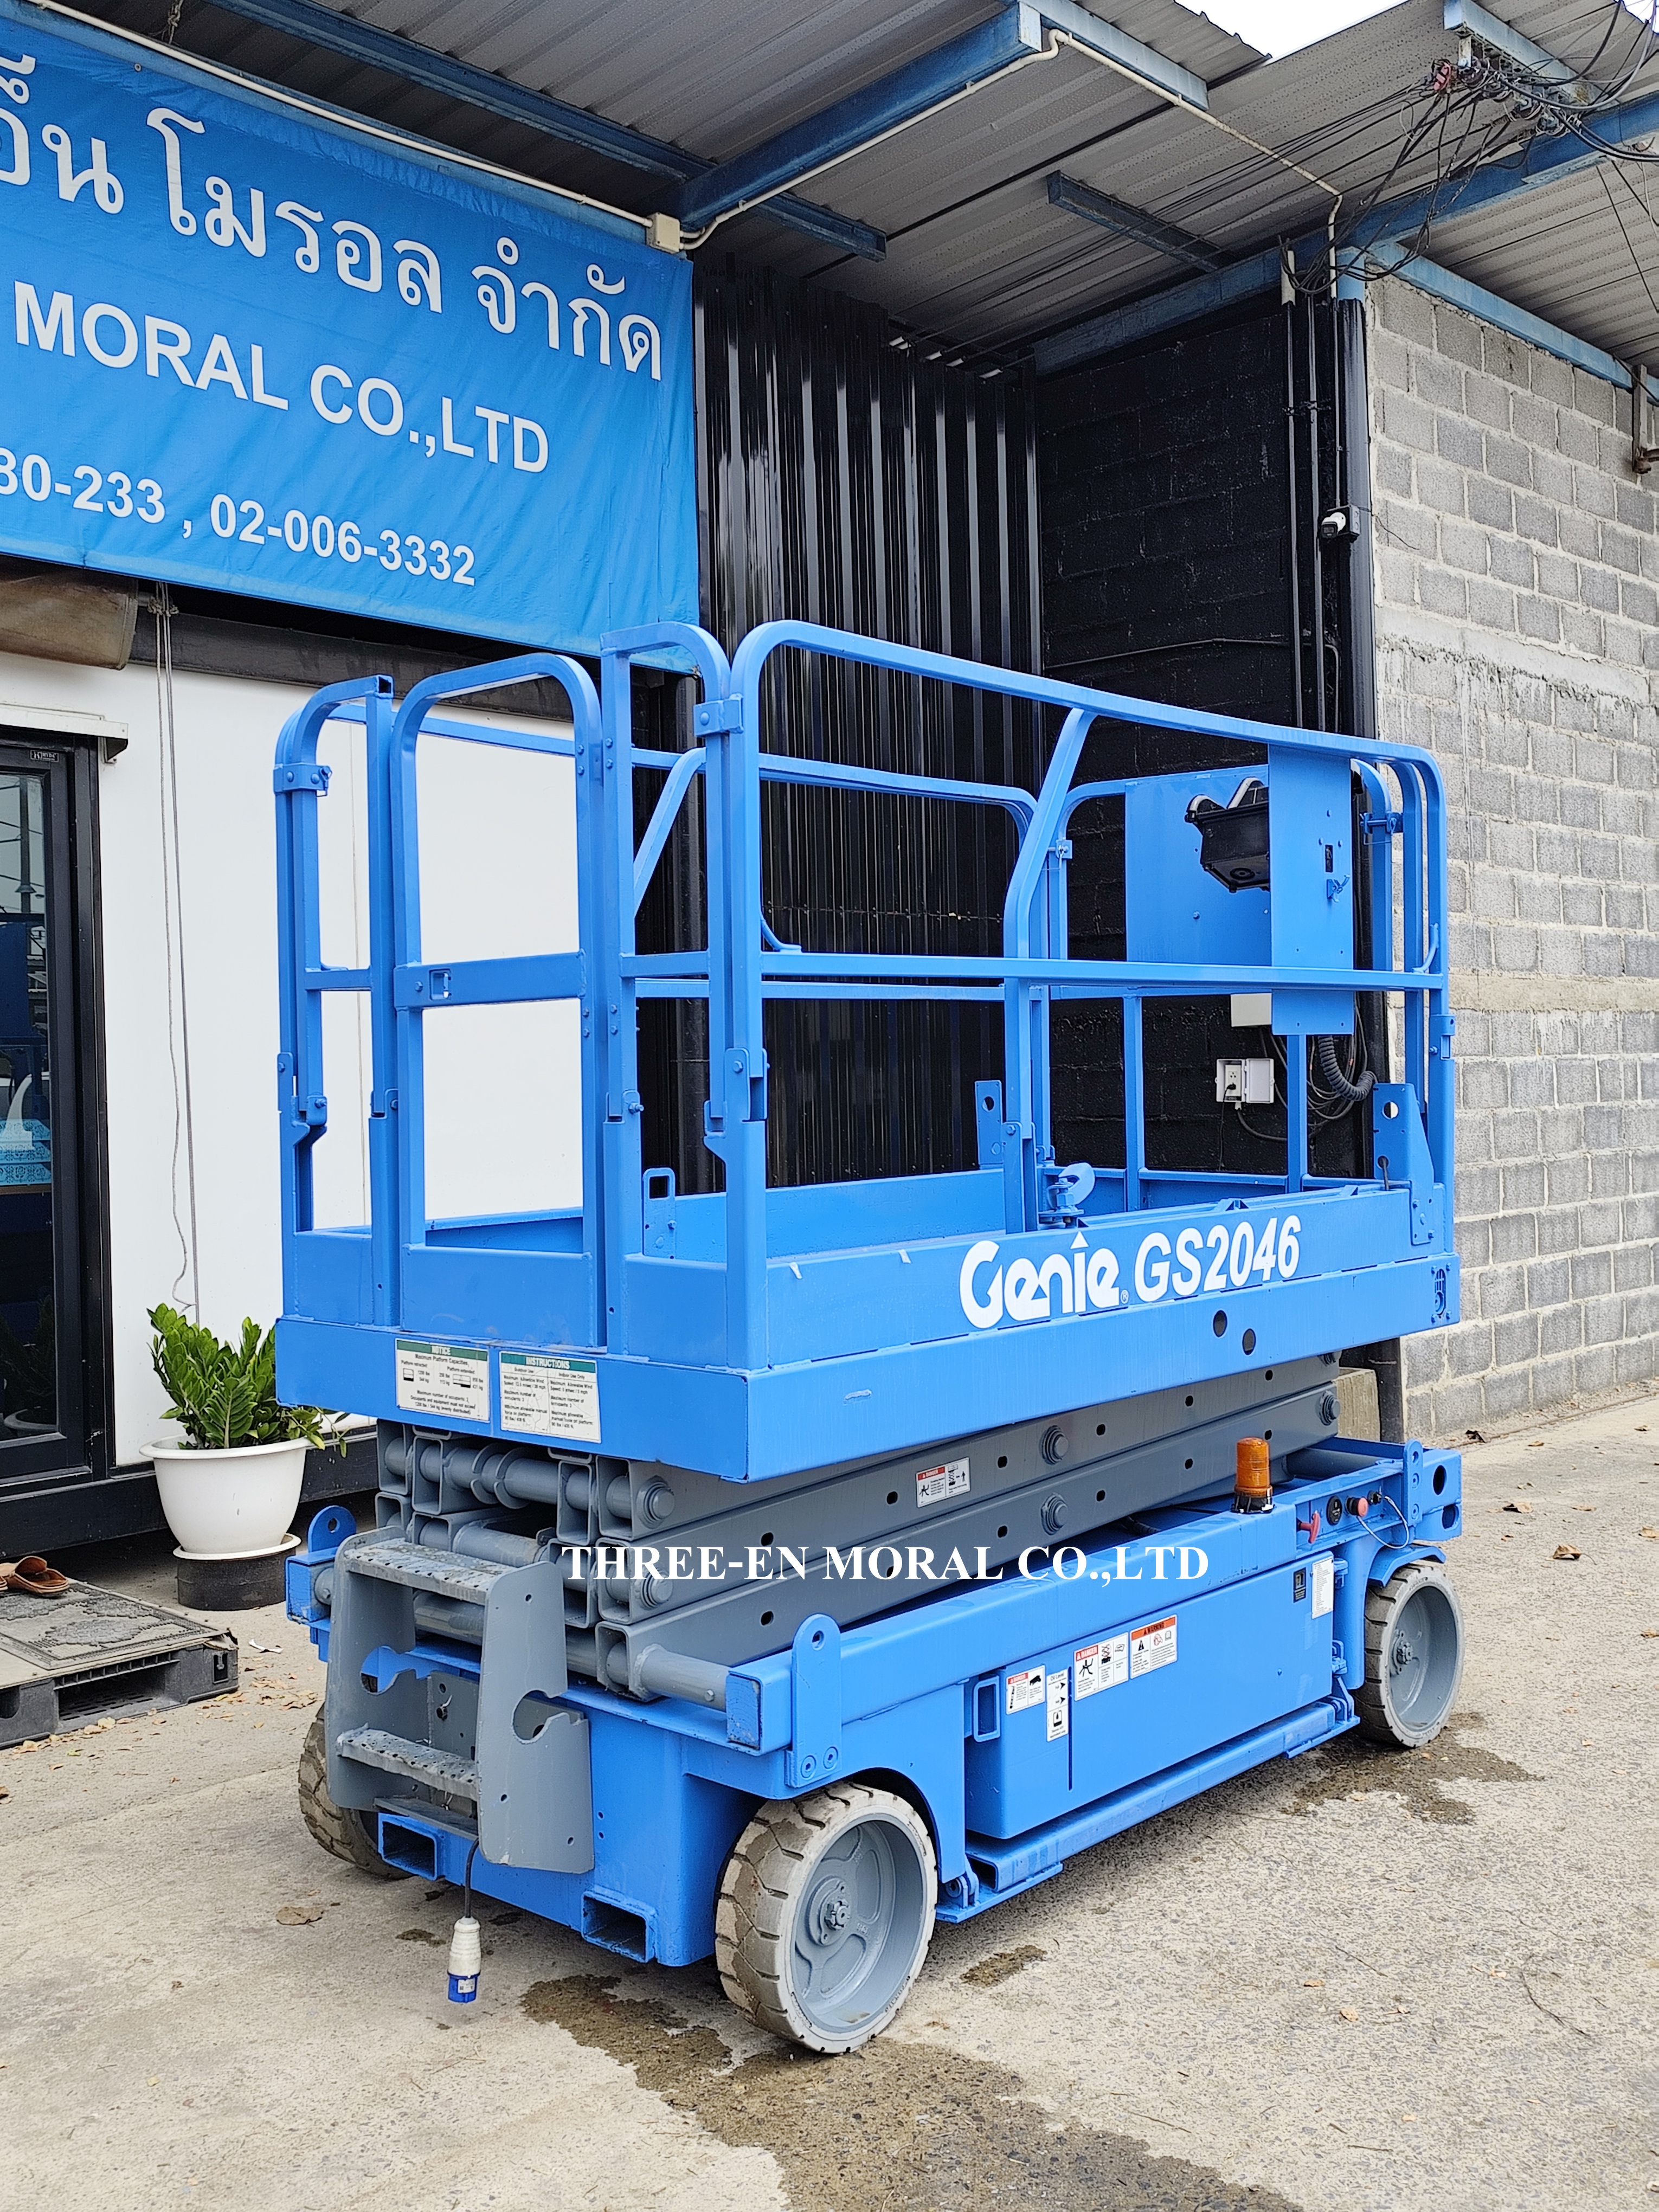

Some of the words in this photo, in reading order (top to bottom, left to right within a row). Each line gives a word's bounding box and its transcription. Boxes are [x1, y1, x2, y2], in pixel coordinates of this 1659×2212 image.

[147, 108, 442, 313] โมรอล
[472, 237, 661, 380] จำกัด
[15, 281, 288, 410] MORAL
[311, 365, 548, 472] CO.,LTD
[210, 494, 474, 586] 02-006-3332
[960, 1231, 1119, 1328] Genie
[1135, 1215, 1301, 1302] GS2046
[526, 1356, 570, 1369] INSTRUCTIONS
